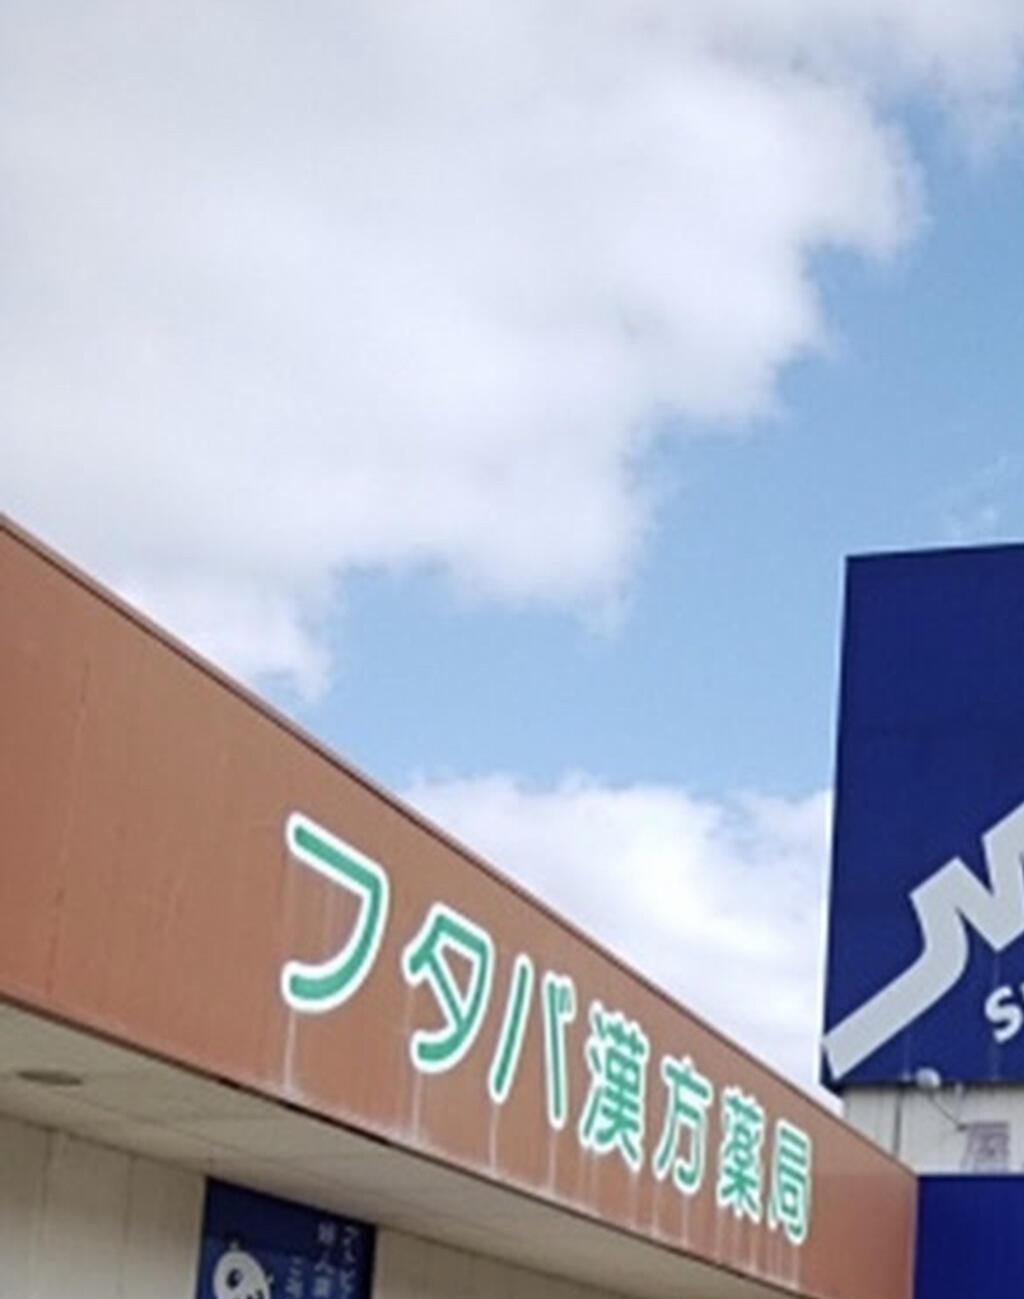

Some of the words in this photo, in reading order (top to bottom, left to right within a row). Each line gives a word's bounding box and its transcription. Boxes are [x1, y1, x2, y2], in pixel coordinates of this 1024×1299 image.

[282, 812, 811, 1244] フタバ漢方薬局
